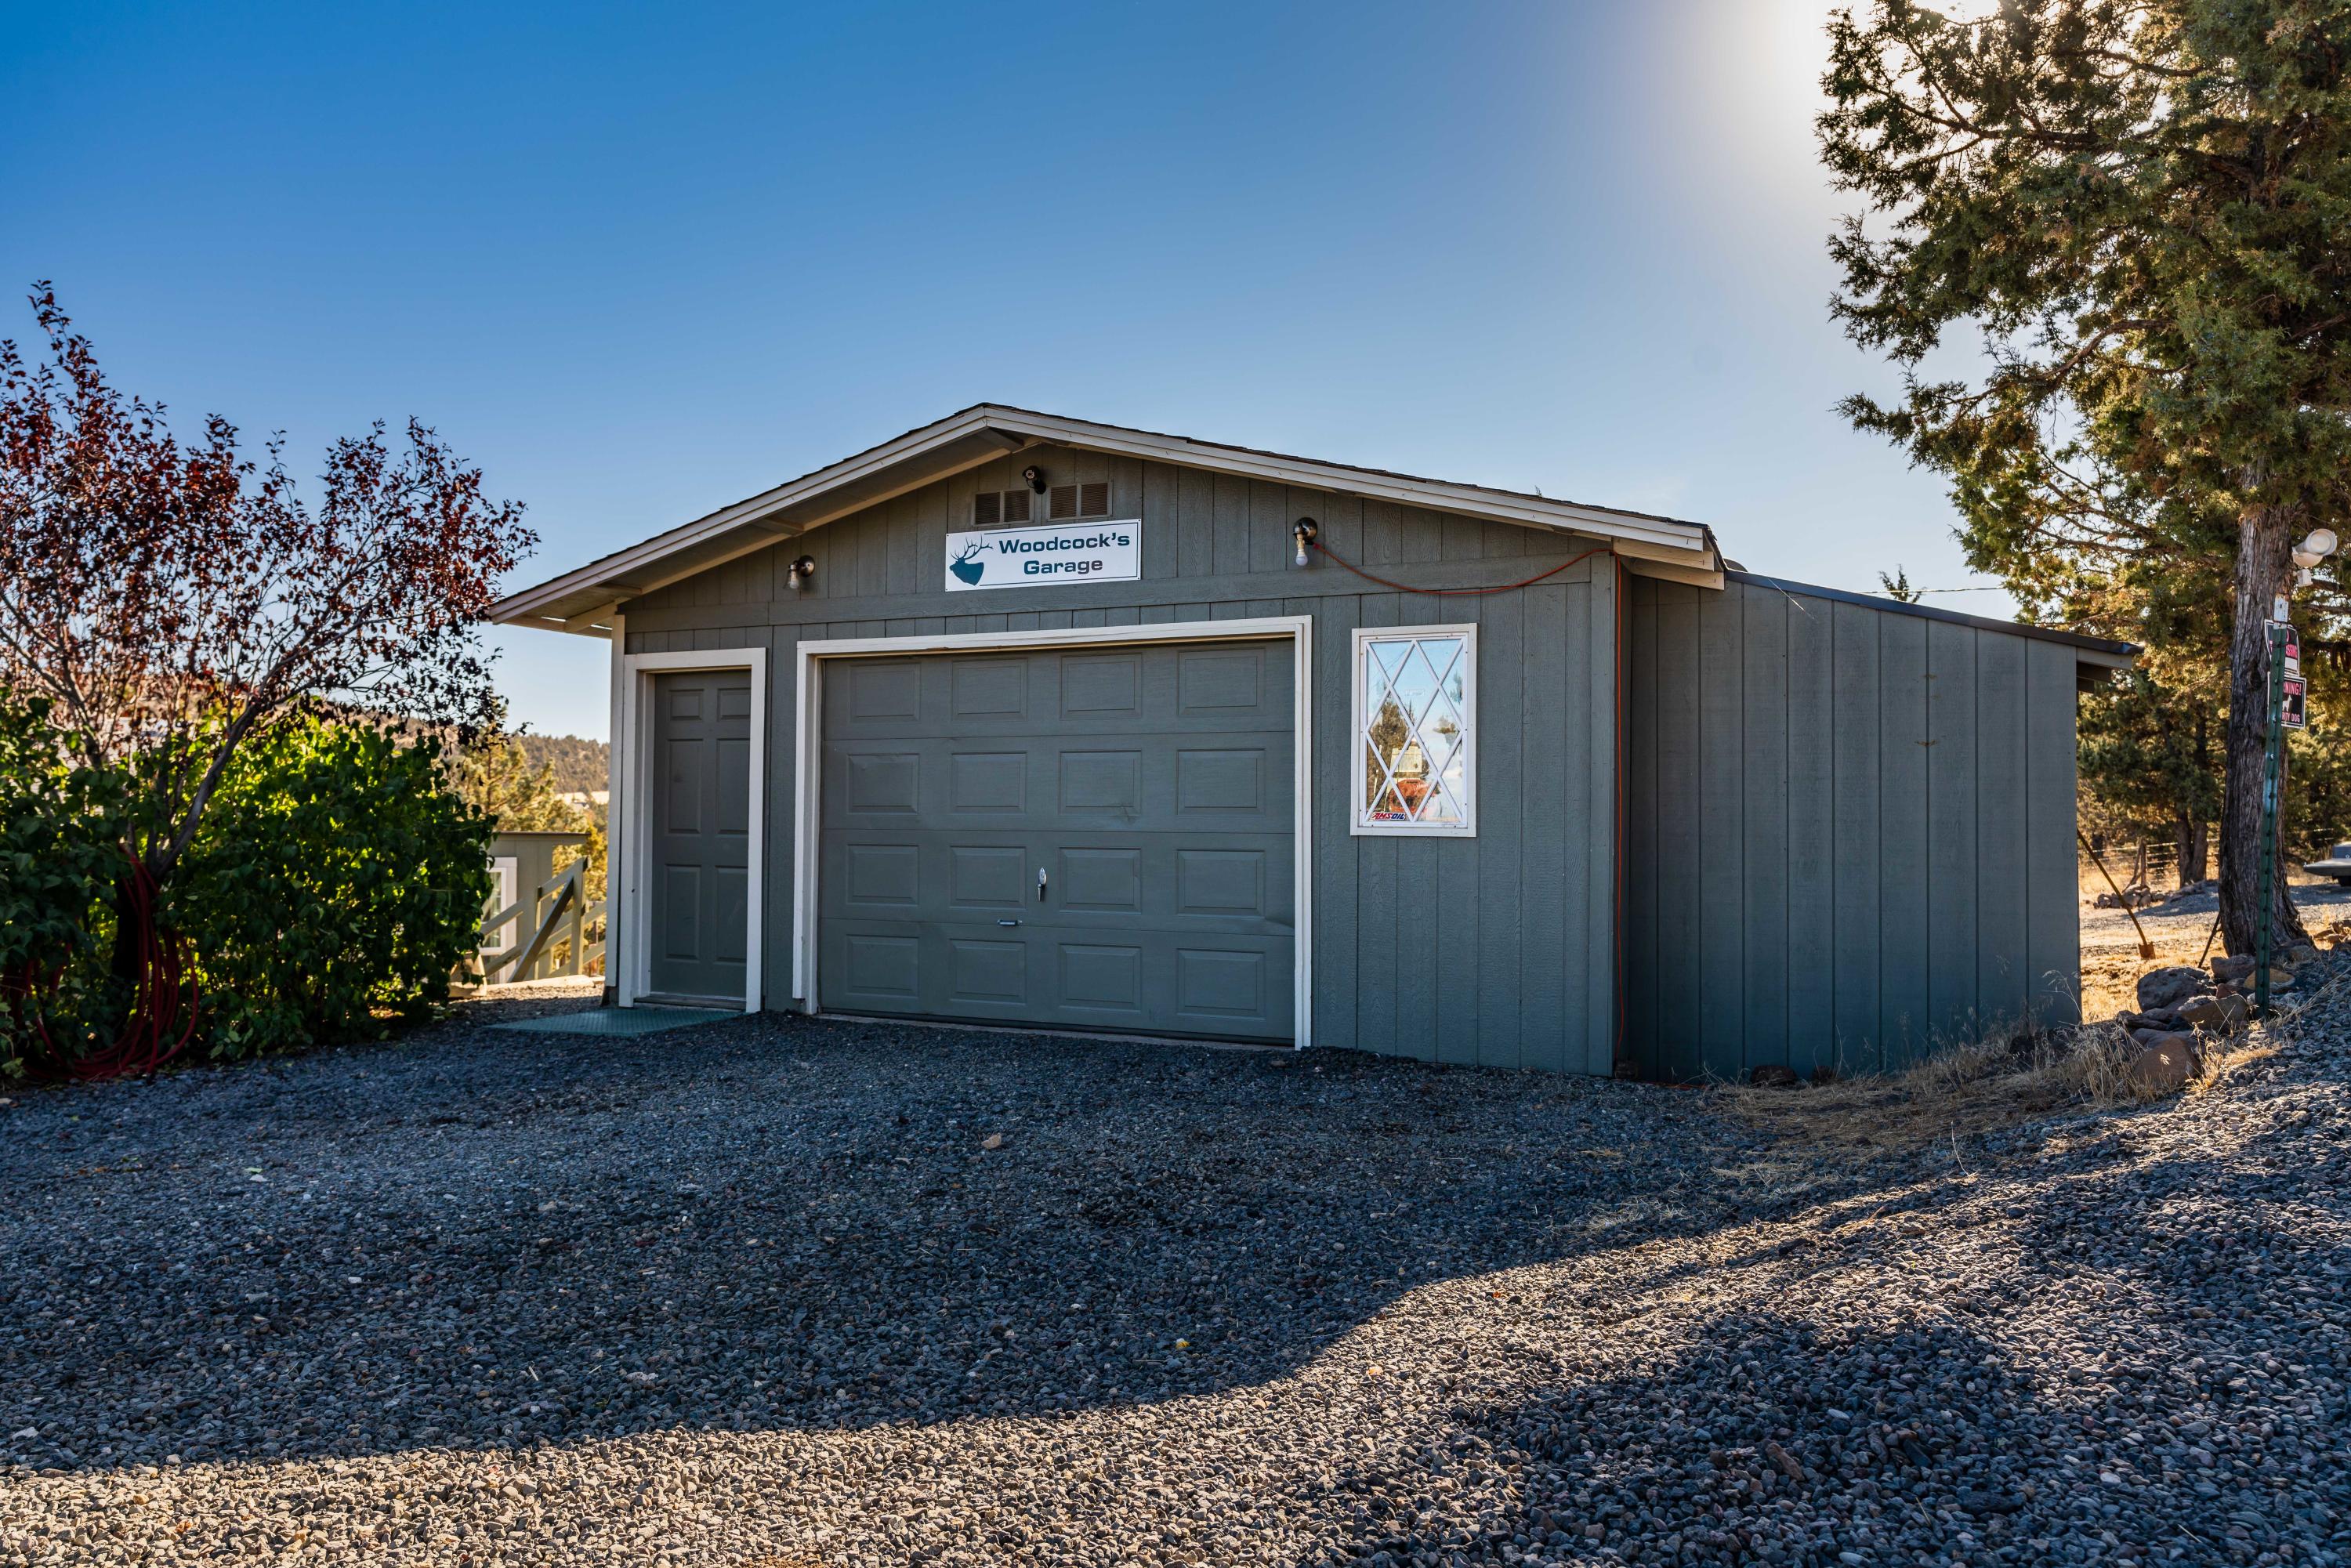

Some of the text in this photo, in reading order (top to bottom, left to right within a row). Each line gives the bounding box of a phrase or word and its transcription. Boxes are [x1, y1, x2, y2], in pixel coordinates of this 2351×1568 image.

[999, 532, 1130, 554] Woodcock's
[1023, 559, 1103, 575] Garage
[2291, 713, 2300, 722] DOG
